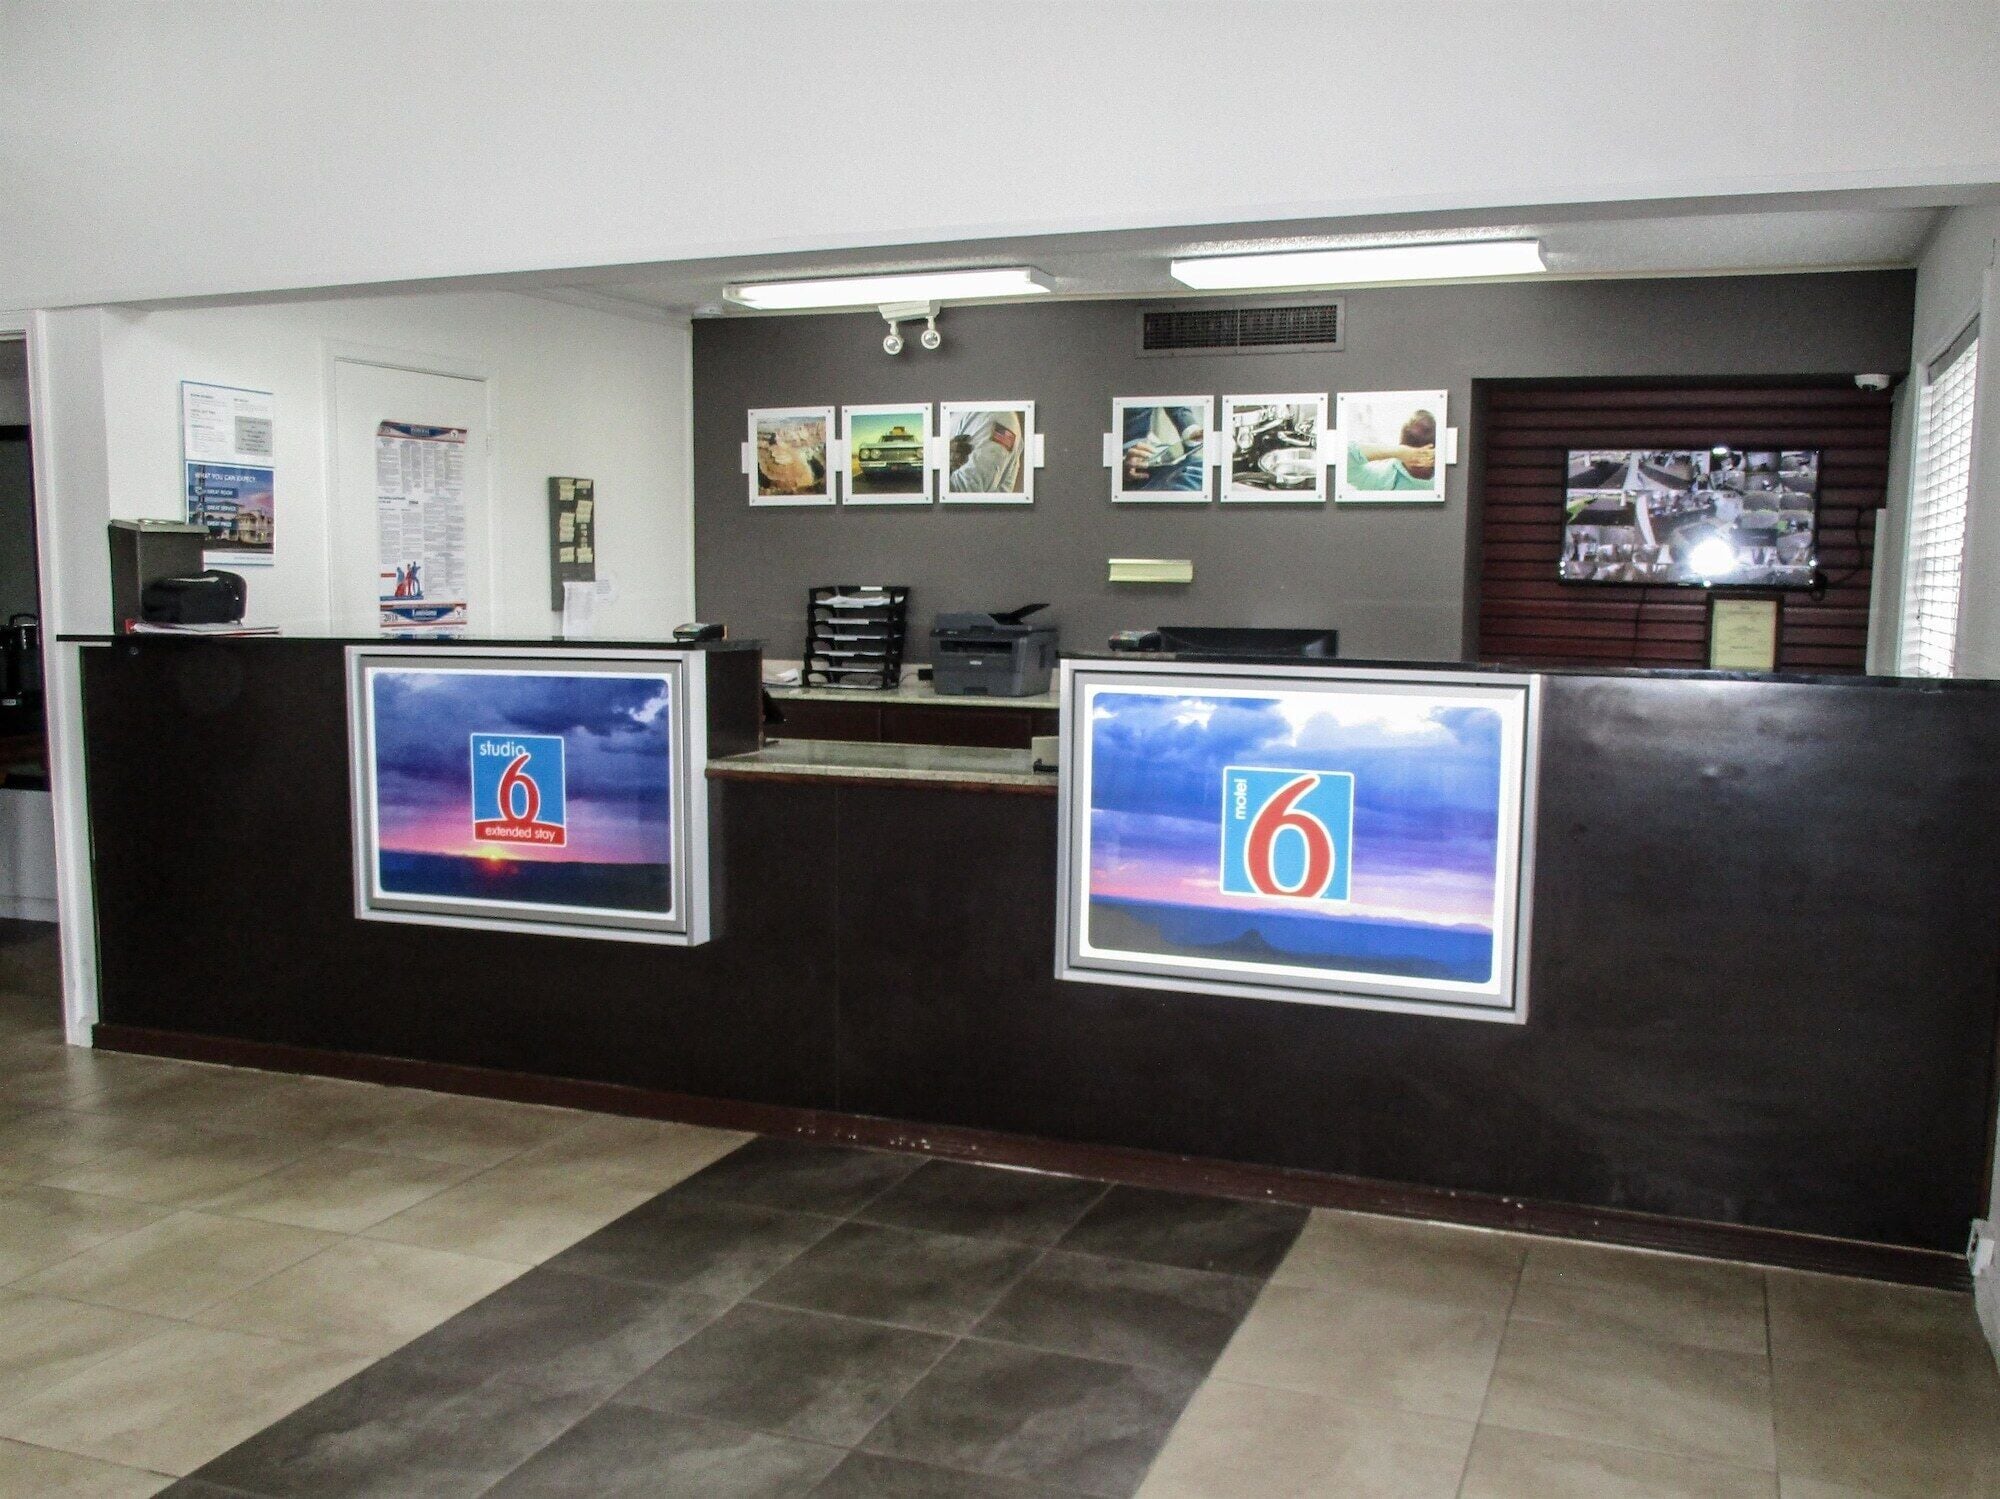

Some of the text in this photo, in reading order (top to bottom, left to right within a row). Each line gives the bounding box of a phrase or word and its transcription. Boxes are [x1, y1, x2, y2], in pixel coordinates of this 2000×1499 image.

[224, 474, 236, 482] CAN
[236, 475, 256, 483] EXPECT
[480, 740, 541, 821] studio 6
[485, 826, 556, 842] extended stay
[1233, 774, 1335, 898] motel 6
